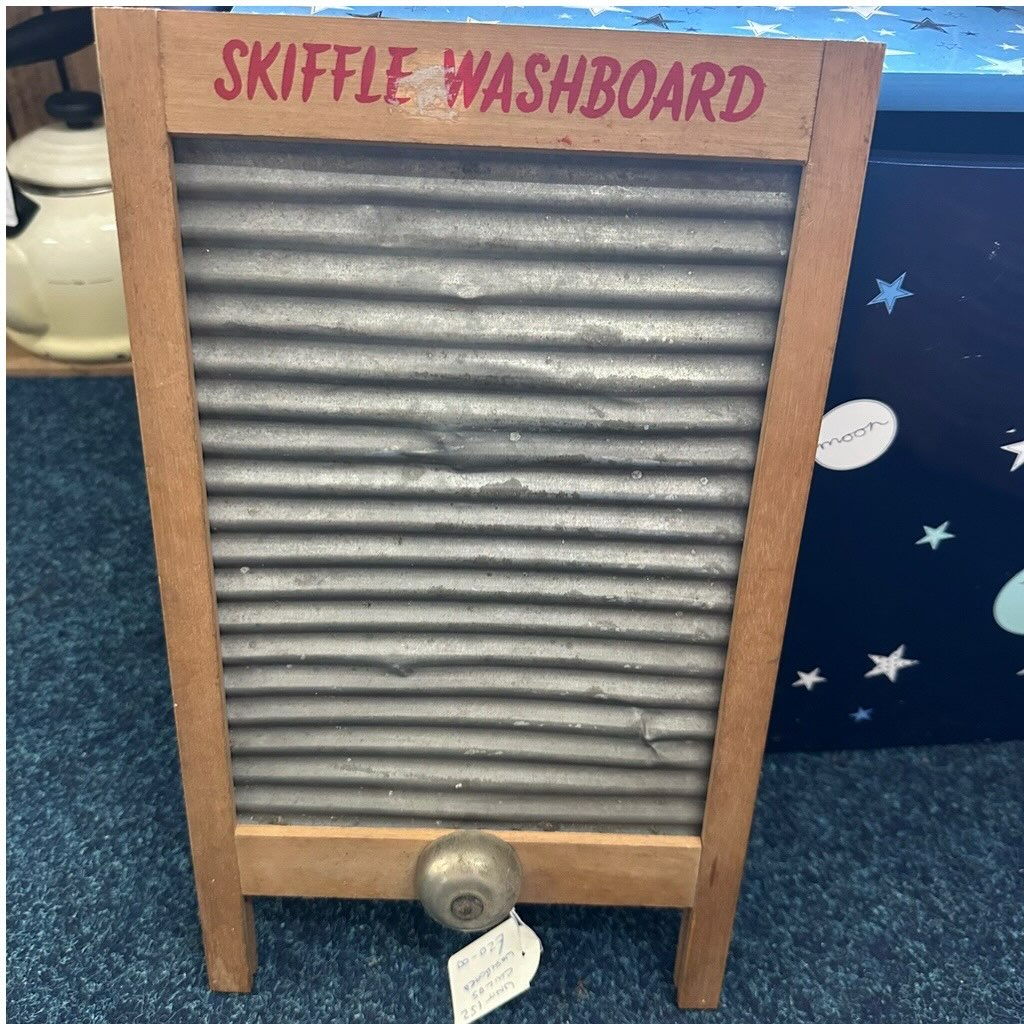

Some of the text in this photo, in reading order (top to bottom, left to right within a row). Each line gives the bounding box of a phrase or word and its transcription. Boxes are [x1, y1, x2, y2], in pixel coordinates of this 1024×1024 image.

[214, 38, 767, 124] SKIFFLE WASHBOARD
[818, 420, 889, 450] moon
